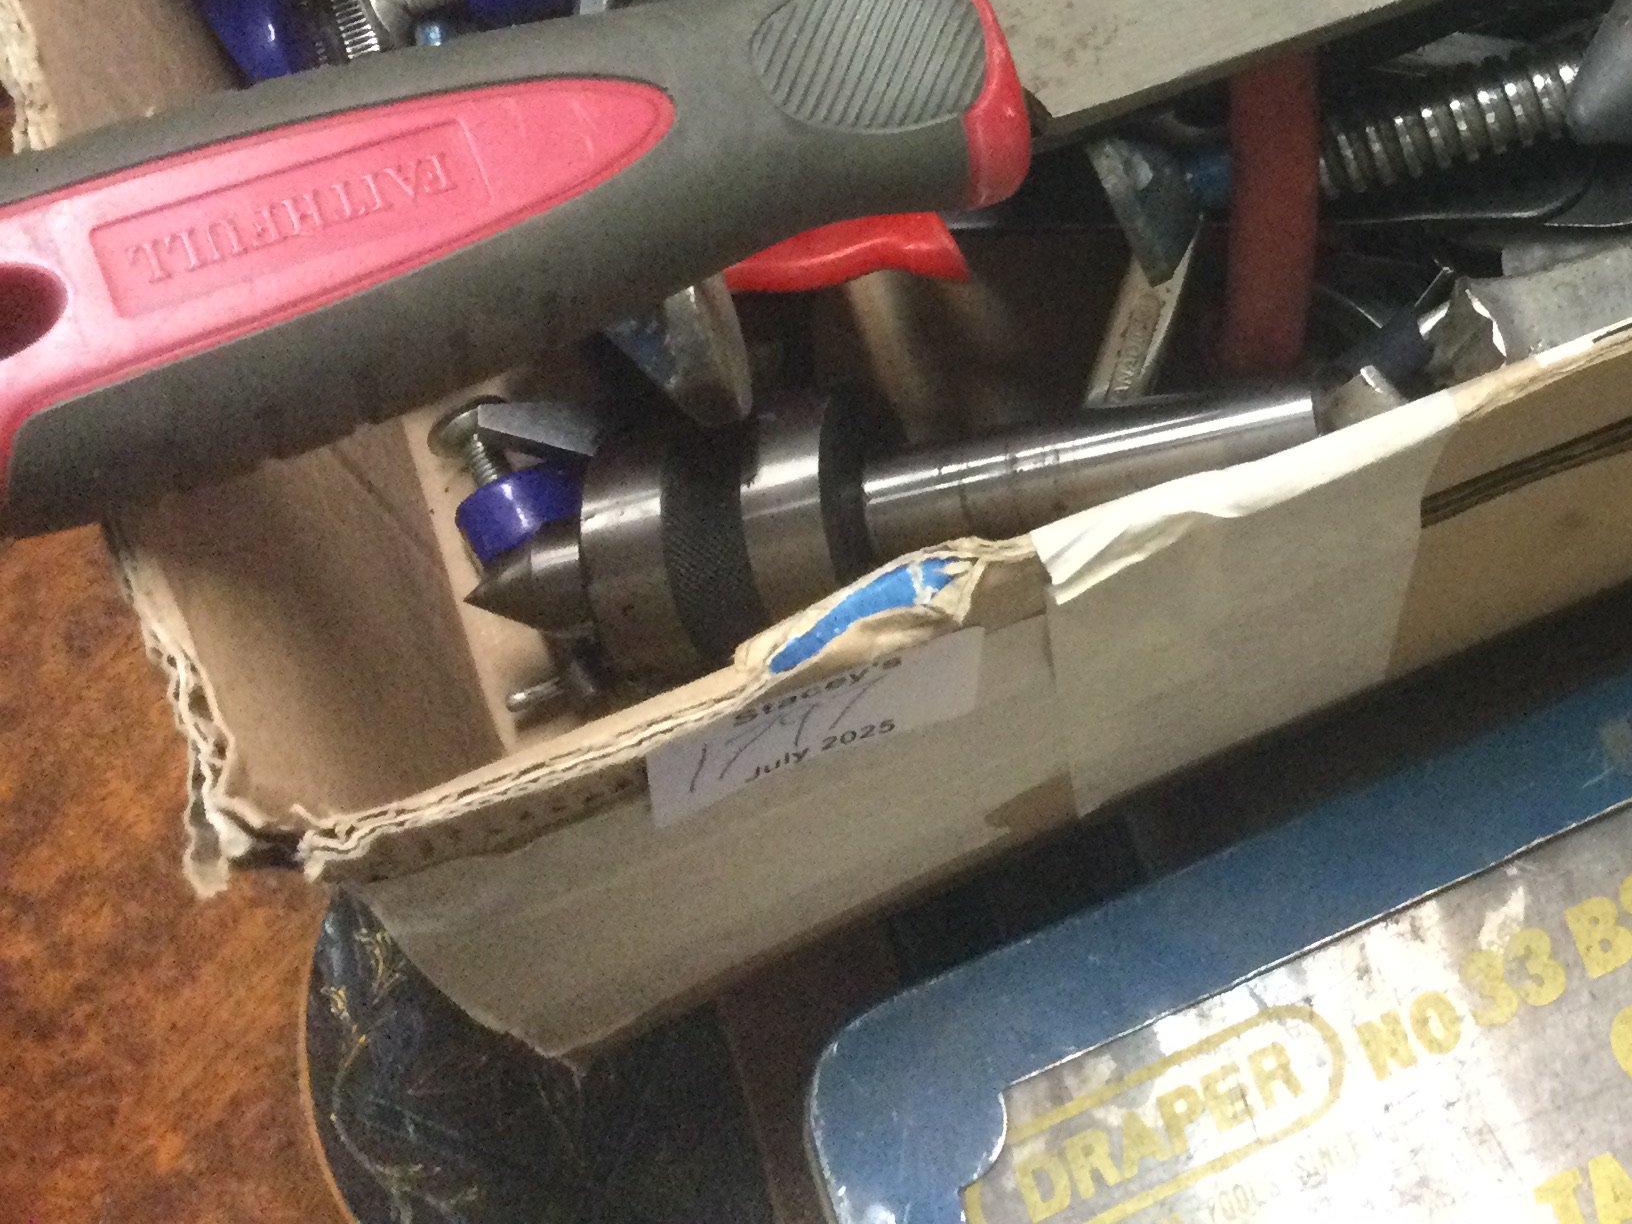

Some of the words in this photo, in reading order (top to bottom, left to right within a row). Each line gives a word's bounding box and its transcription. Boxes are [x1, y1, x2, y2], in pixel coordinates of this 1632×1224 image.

[130, 152, 457, 283] FAITHFULL
[745, 746, 810, 783] July
[822, 718, 896, 753] 2025
[1012, 1040, 1305, 1224] DRAPER
